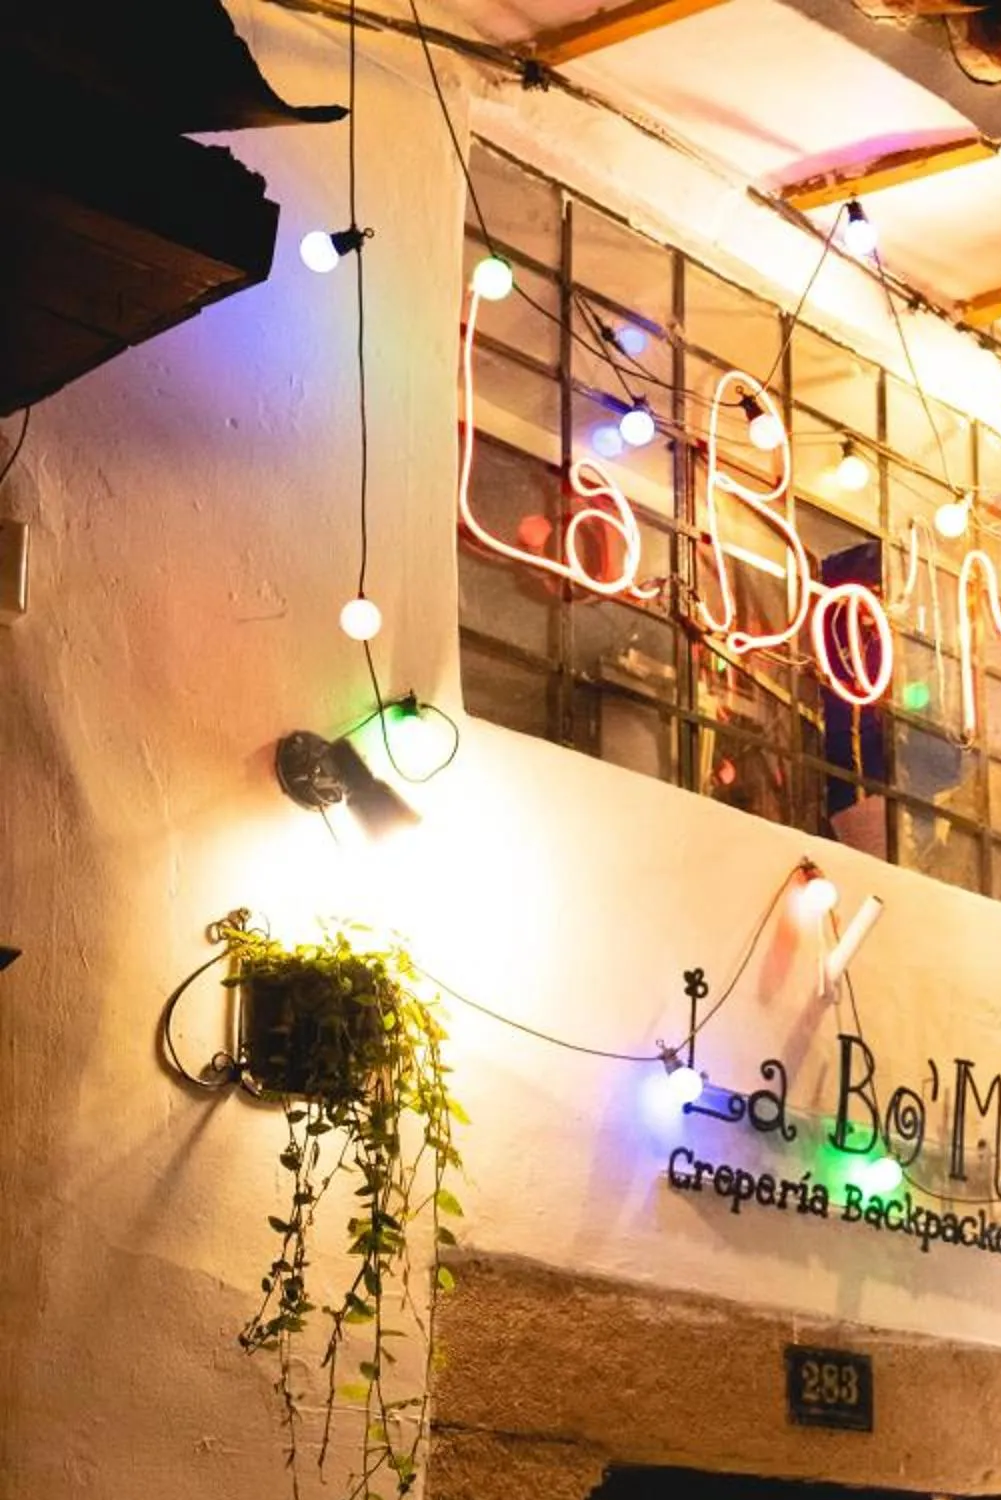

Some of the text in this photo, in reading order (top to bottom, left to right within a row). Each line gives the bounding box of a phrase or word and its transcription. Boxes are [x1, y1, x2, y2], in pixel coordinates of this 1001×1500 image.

[460, 286, 659, 600] La
[683, 967, 797, 1142] La
[668, 1146, 830, 1219] Crepería
